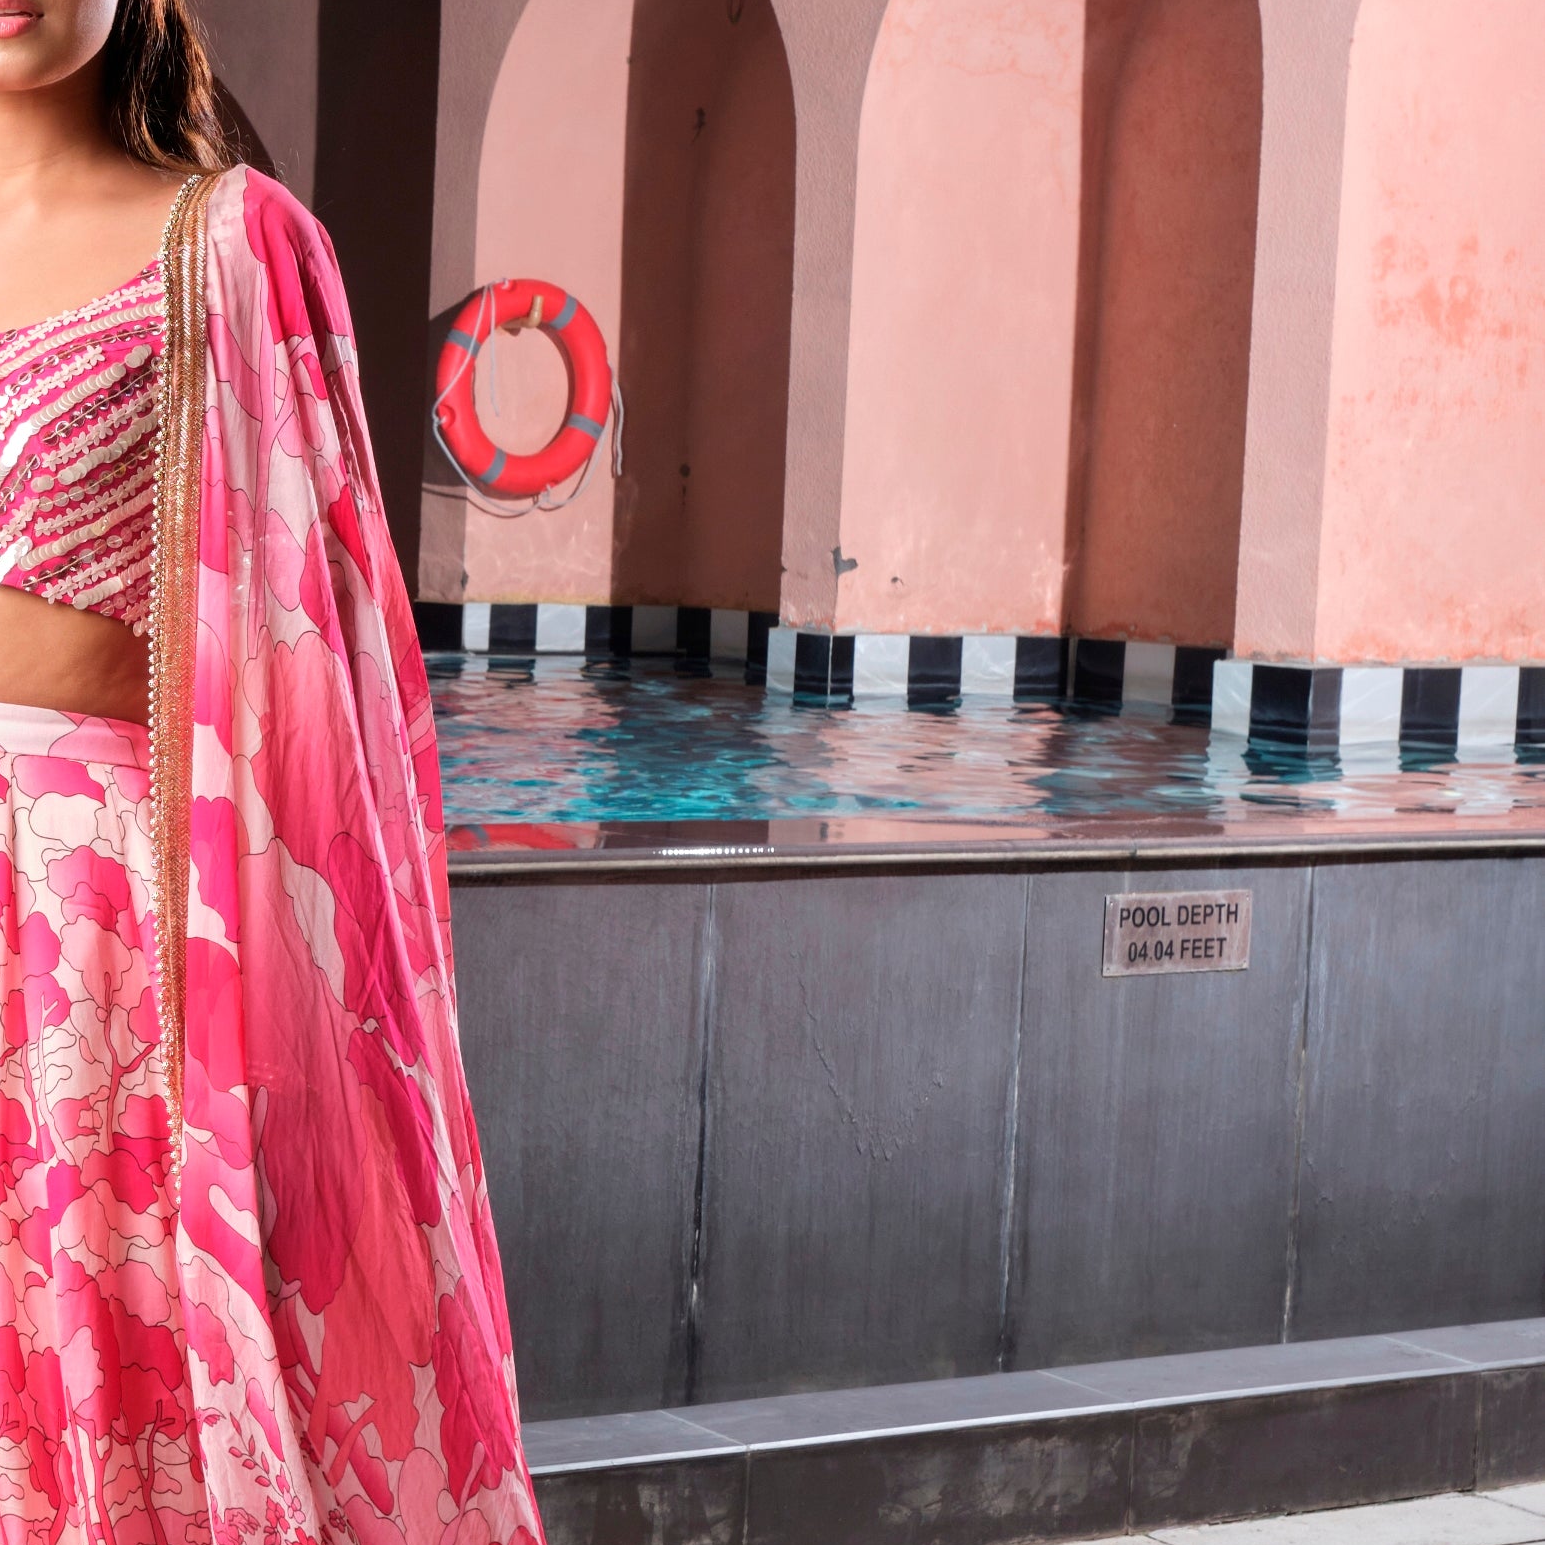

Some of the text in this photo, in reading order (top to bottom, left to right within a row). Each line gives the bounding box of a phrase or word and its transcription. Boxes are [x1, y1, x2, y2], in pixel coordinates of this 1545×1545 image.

[1119, 903, 1238, 928] POOL DEPTH
[1128, 937, 1227, 962] 04.04 FEET
